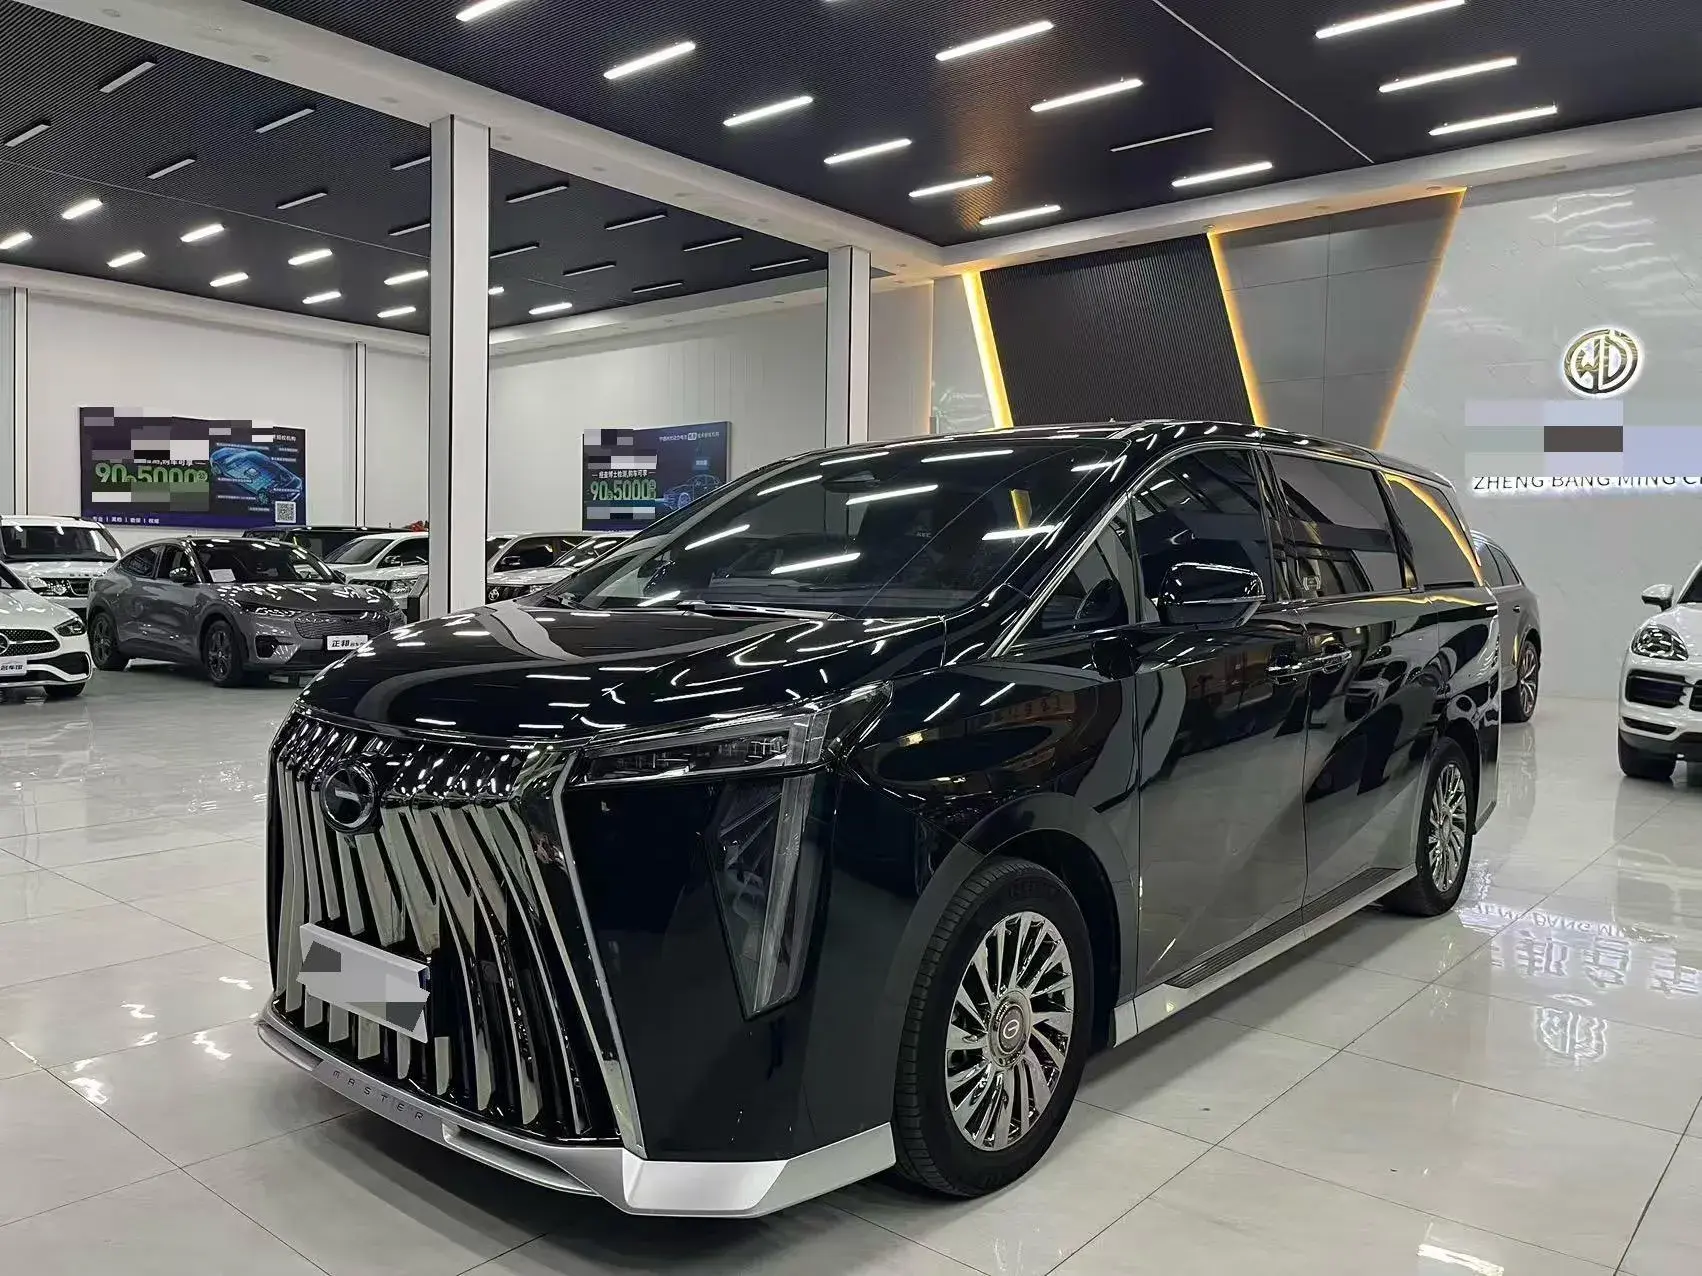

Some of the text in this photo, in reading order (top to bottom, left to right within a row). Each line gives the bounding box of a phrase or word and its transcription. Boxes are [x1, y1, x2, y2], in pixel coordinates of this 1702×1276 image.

[1473, 476, 1544, 490] ZHENG
[1551, 476, 1611, 488] BANG
[332, 1069, 424, 1121] MASTER
